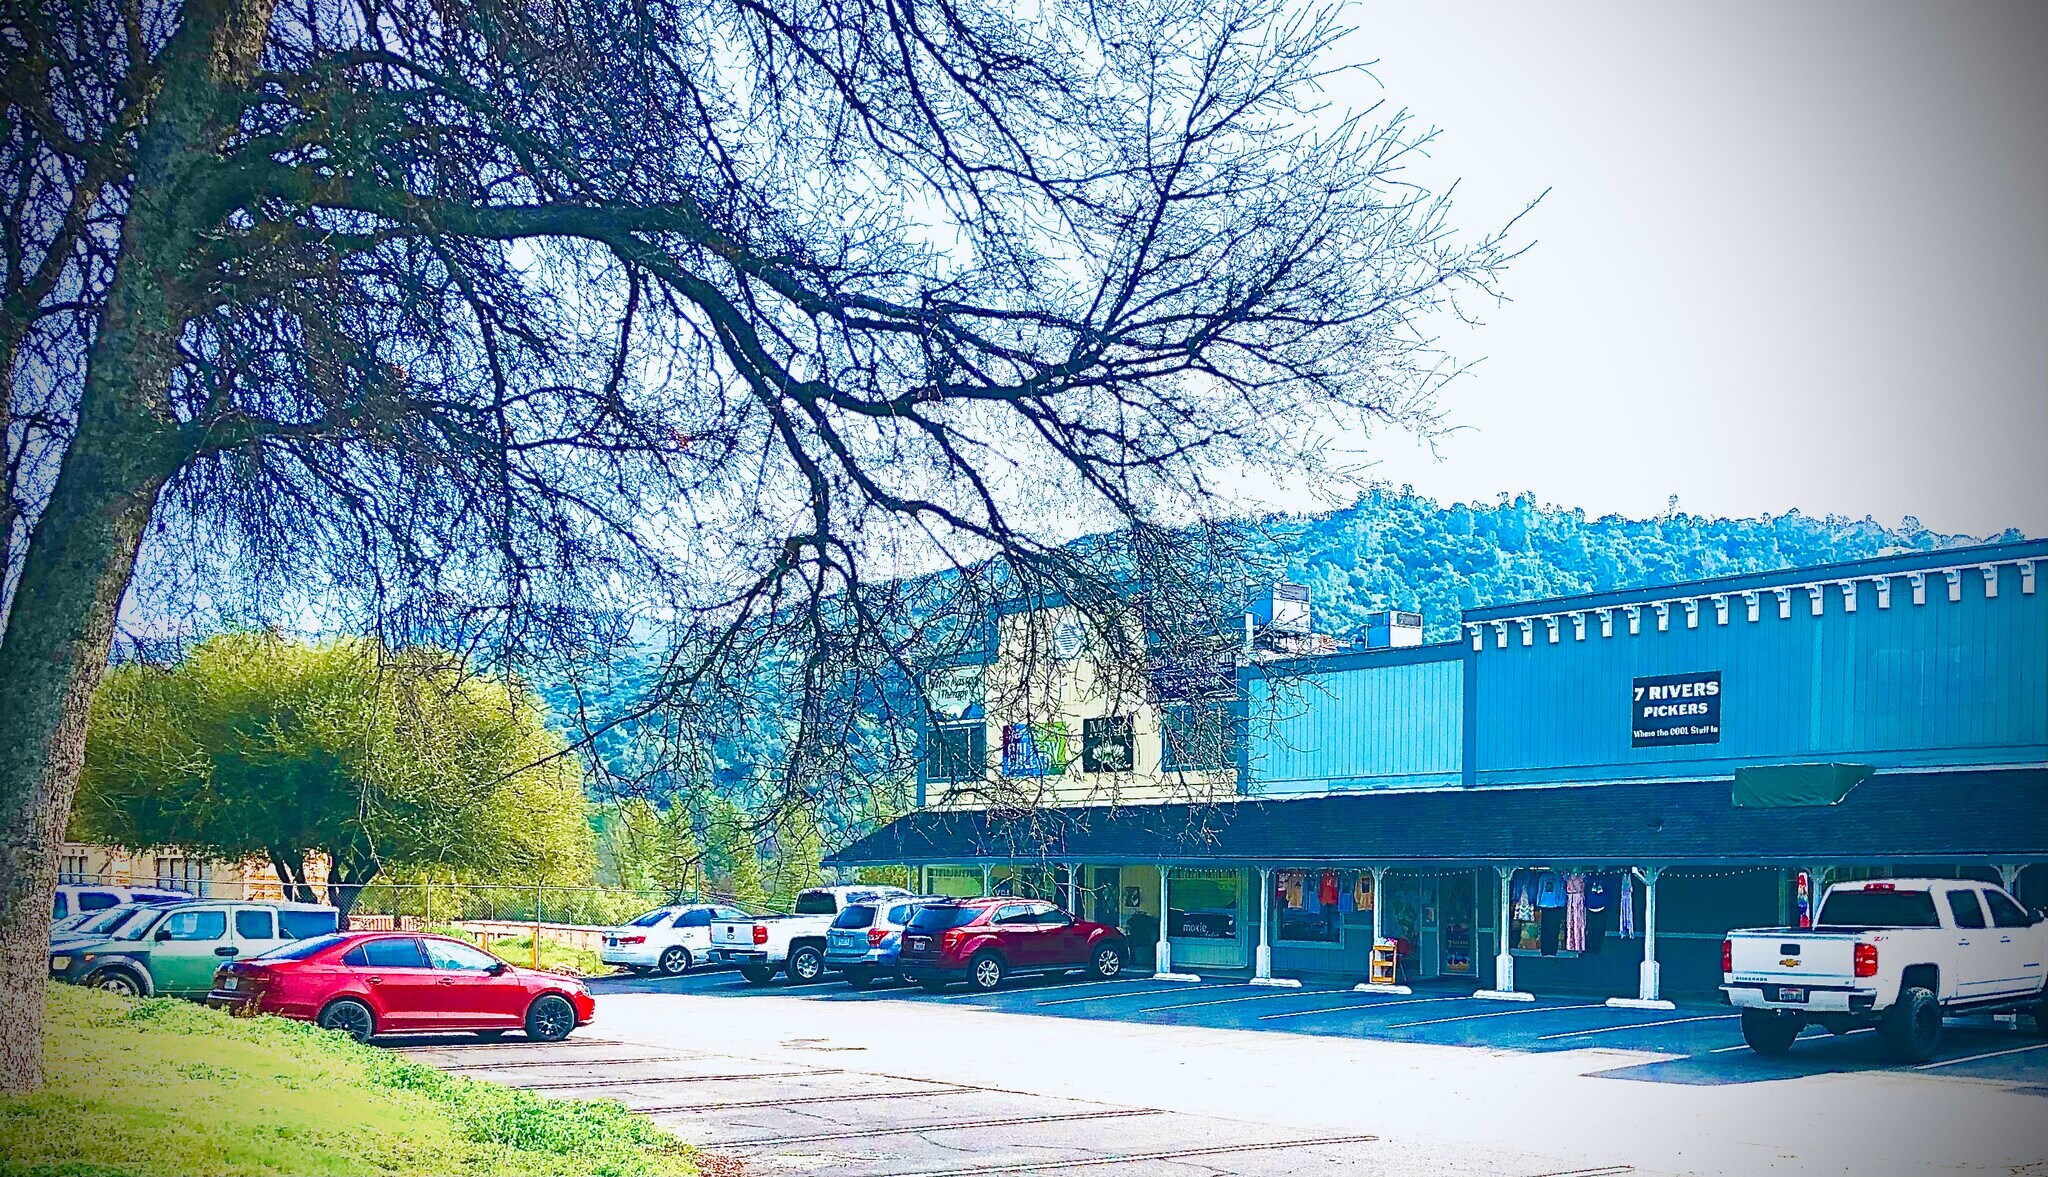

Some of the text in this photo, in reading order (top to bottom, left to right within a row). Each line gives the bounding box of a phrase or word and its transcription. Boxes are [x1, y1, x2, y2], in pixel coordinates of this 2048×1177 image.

[1634, 681, 1719, 701] 7 RIVERS
[1643, 702, 1708, 718] PICKERS
[1633, 729, 1655, 738] Where
[1656, 728, 1669, 737] the
[1670, 726, 1689, 736] COOL
[1690, 725, 1709, 734] Stuff
